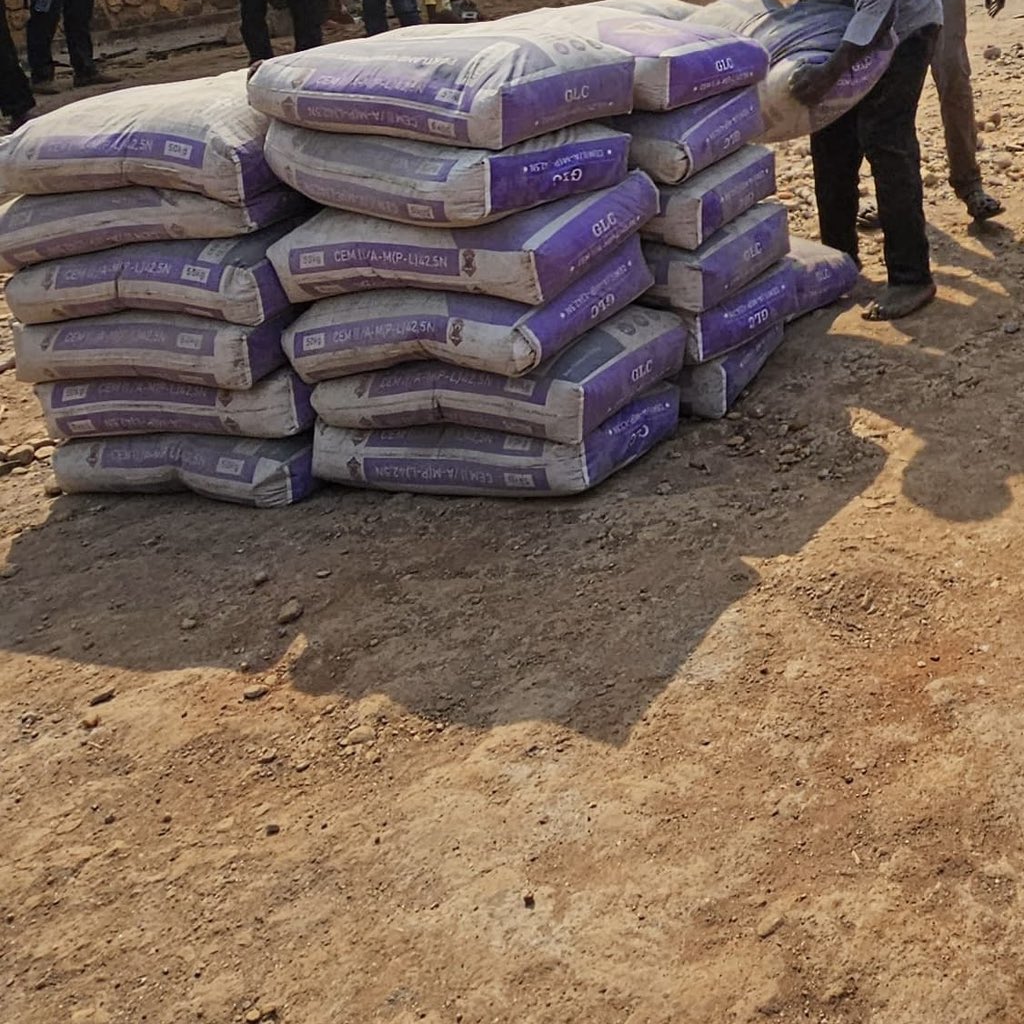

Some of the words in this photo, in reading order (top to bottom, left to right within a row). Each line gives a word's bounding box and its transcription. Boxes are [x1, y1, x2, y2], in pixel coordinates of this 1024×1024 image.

[565, 85, 589, 102] GLC
[592, 212, 617, 237] GLC
[748, 308, 769, 329] GLC
